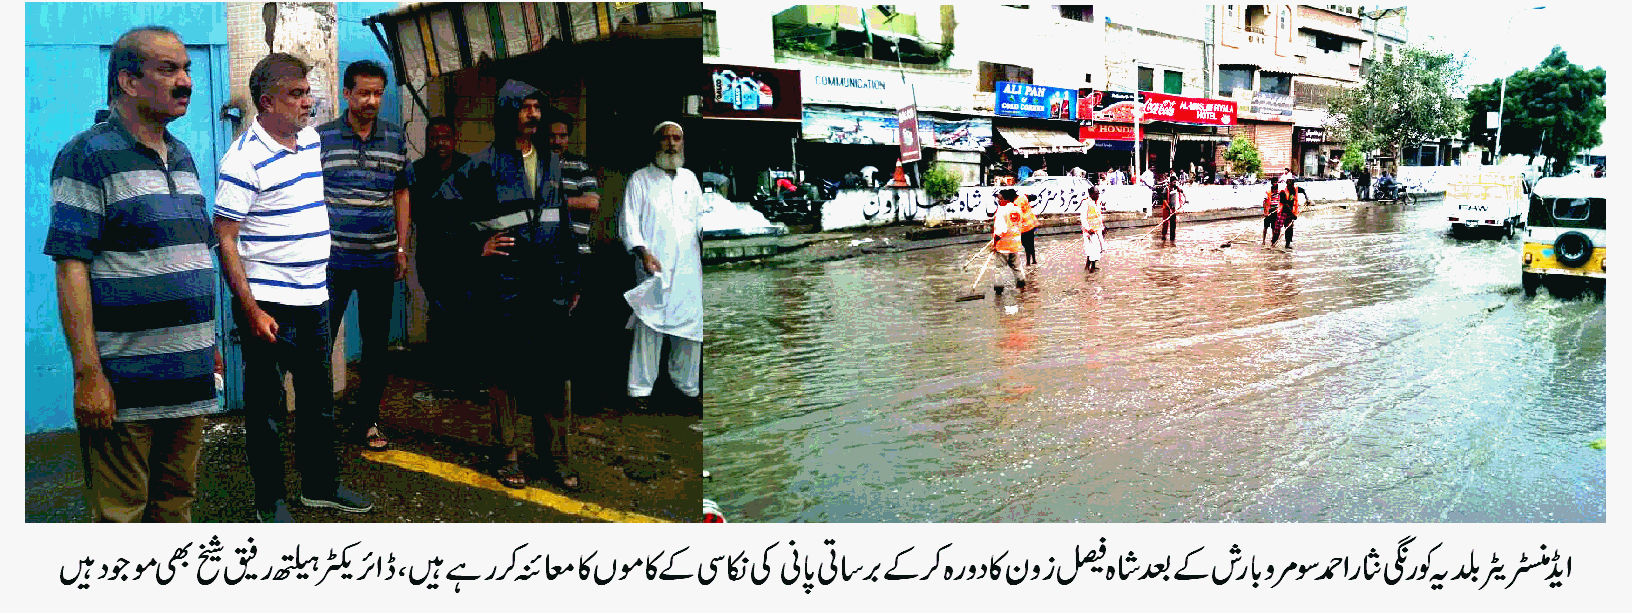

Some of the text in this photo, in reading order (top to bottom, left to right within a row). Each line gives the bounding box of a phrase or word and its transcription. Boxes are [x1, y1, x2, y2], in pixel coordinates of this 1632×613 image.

[815, 75, 886, 90] COMMUNICATION
[1003, 83, 1047, 98] ALI PAN
[1196, 110, 1218, 120] HOTEL
